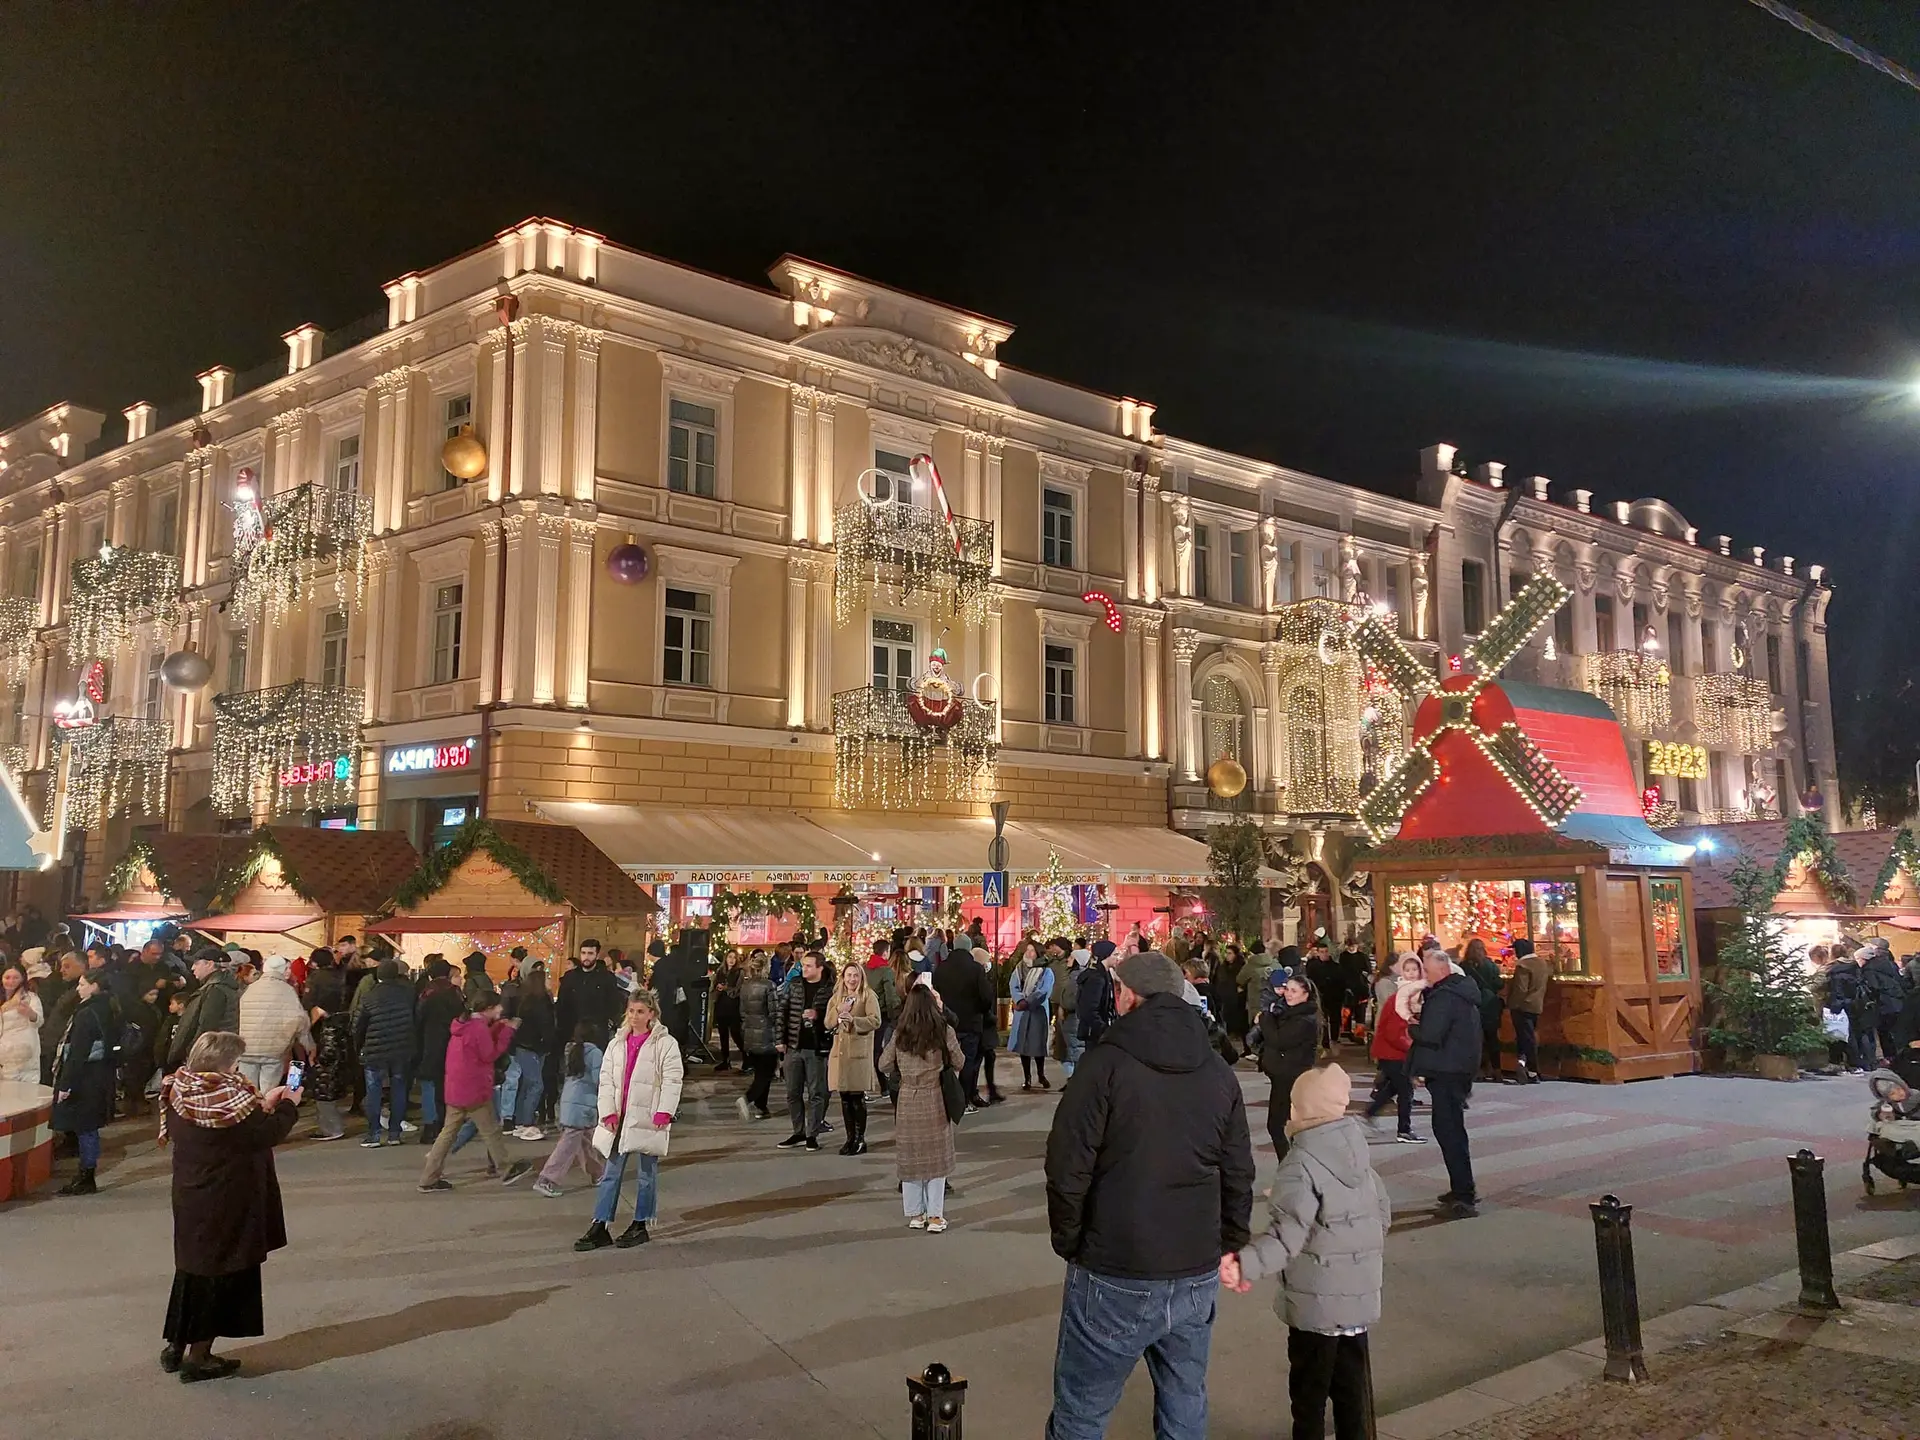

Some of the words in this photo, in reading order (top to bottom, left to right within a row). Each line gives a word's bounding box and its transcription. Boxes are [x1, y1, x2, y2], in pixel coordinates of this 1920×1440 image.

[1648, 740, 1707, 780] 2023
[691, 872, 751, 882] RADIOCAFE
[824, 872, 876, 882] RADIOCAFE
[958, 876, 984, 884] RADIO
[1163, 875, 1199, 884] RADIOCAFE
